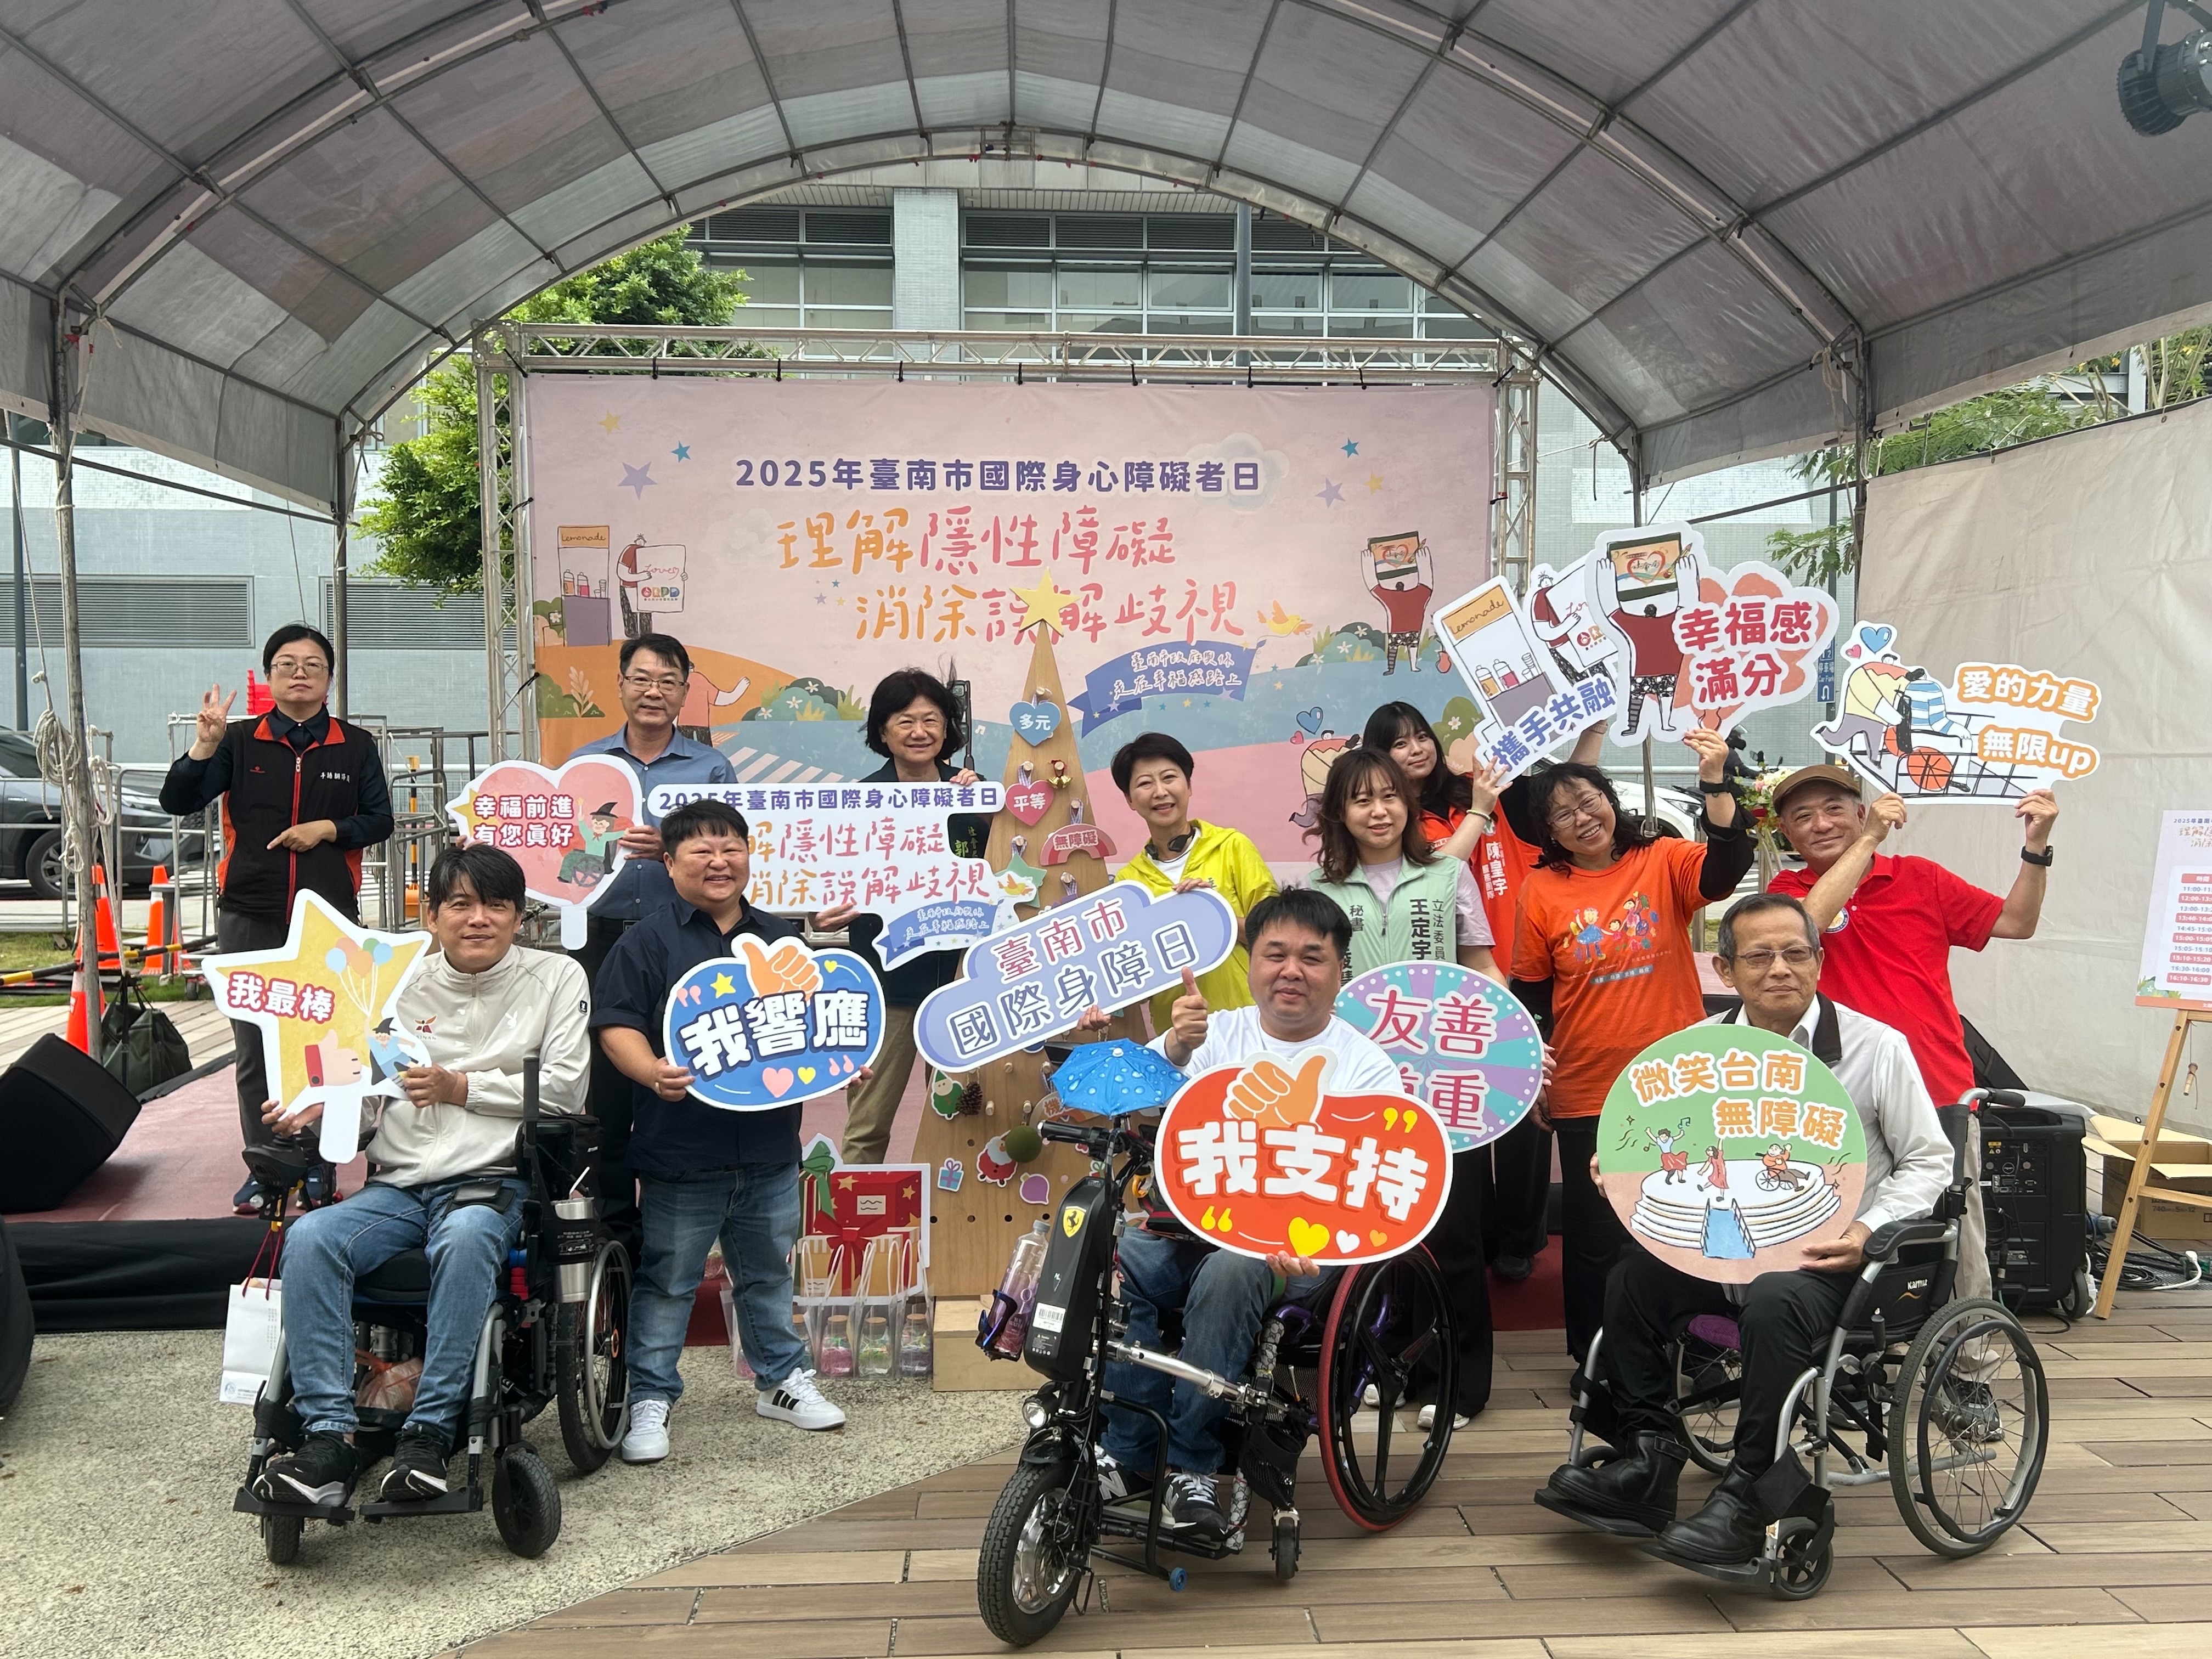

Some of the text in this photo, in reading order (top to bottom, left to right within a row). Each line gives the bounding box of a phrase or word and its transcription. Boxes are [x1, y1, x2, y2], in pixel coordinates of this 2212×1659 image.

[736, 458, 1260, 493] 2025年臺南市國際身心障礙者日
[561, 532, 606, 542] Lemonade
[777, 505, 1175, 575] 理解隱性障礙
[645, 564, 677, 575] Love
[1449, 599, 1504, 634] Lemonade
[1680, 601, 1813, 651] 幸福感
[1696, 654, 1782, 704] 滿分
[1962, 669, 2093, 718] 愛的力量
[1019, 713, 1051, 731] 多元
[1491, 678, 1615, 772] 攜手共融
[1983, 729, 2091, 775] 無限up
[474, 795, 574, 819] 幸福前進
[1013, 792, 1046, 812] 平等
[747, 815, 945, 863] 解隱性障礙
[1054, 830, 1098, 848] 無障礙
[1486, 841, 1508, 895] 陳皇宇
[992, 900, 1126, 981] 臺南市
[1350, 904, 1364, 932] 秘書
[1409, 898, 1431, 960] 王定宇
[1432, 899, 1446, 960] 立法委員
[229, 973, 334, 1022] 我最棒
[950, 924, 1197, 1055] 國際身障日
[680, 990, 868, 1076] 我響應
[1371, 990, 1496, 1055] 友善
[1632, 1052, 1803, 1103] 微笑台南
[1716, 1101, 1846, 1147] 無障礙
[1178, 1121, 1428, 1221] 我支持
